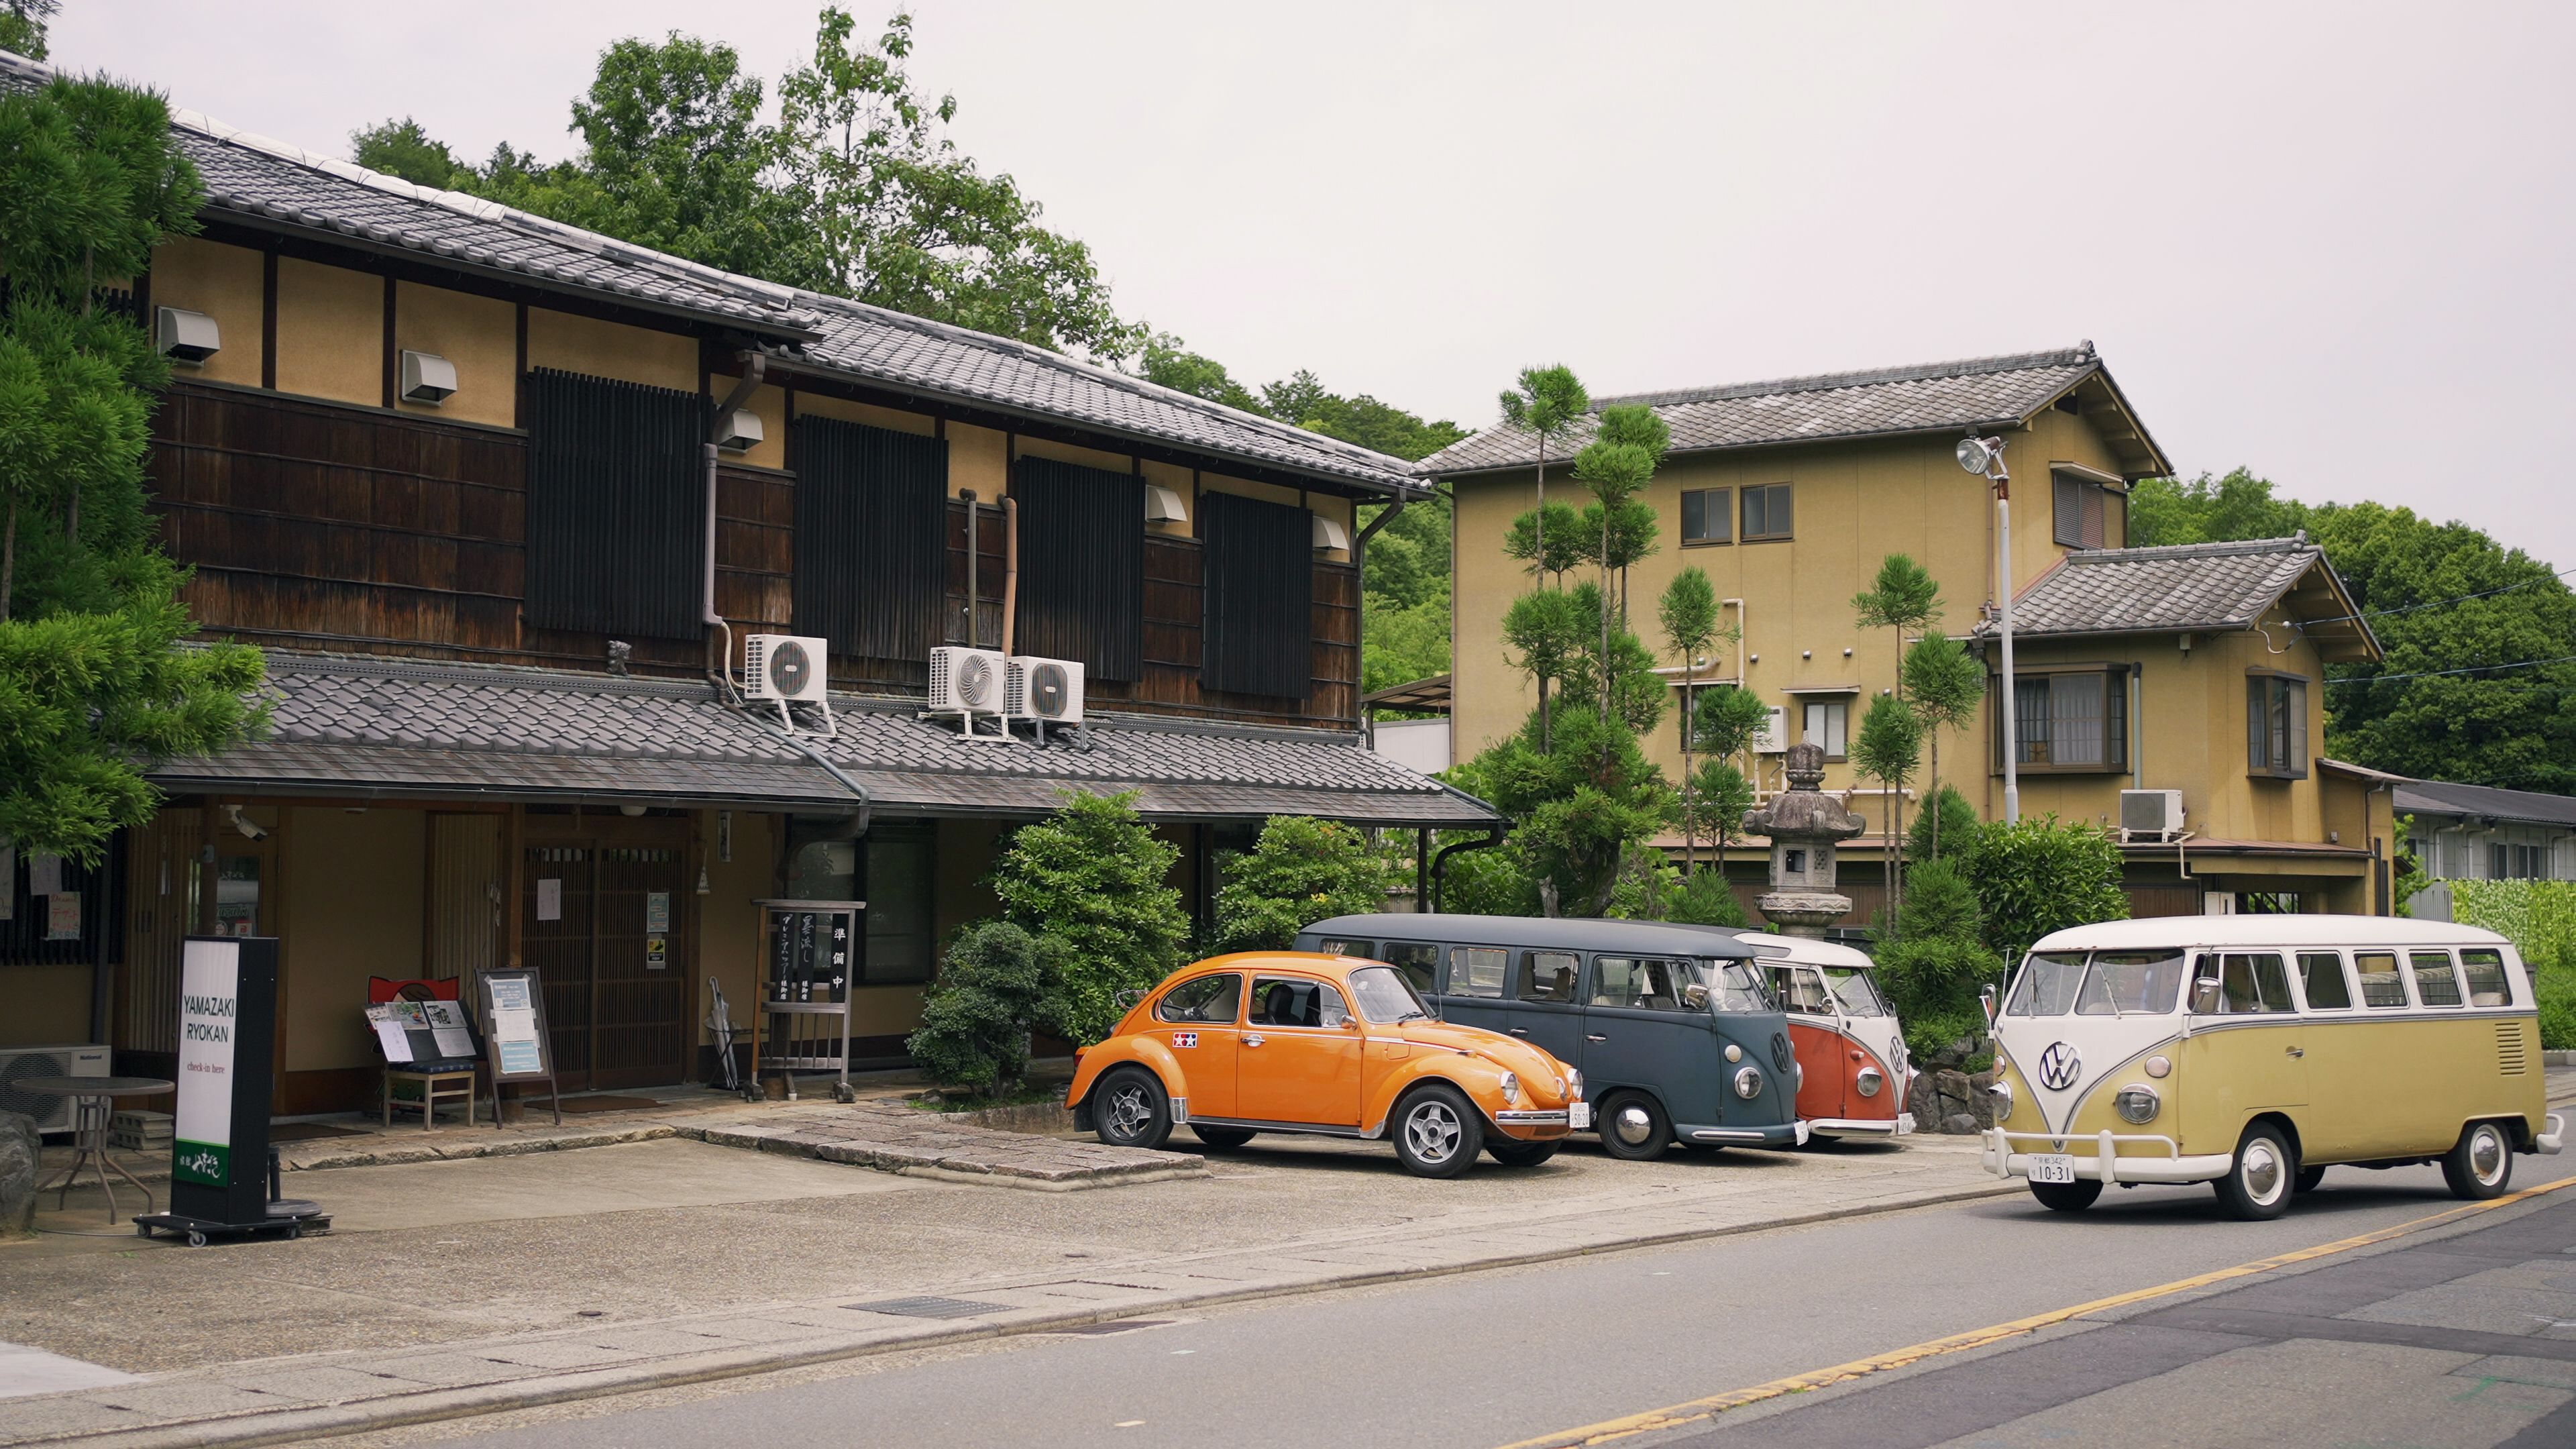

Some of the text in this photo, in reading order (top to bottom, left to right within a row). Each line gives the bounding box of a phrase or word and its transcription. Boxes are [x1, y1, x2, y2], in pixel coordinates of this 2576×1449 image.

[832, 928, 847, 989] 準備中
[184, 995, 235, 1018] YAMAZAKI
[186, 1022, 229, 1043] RYOKAN
[187, 1061, 225, 1074] check-in here
[1574, 1113, 1589, 1126] 50-20
[2039, 1165, 2070, 1181] 10-31
